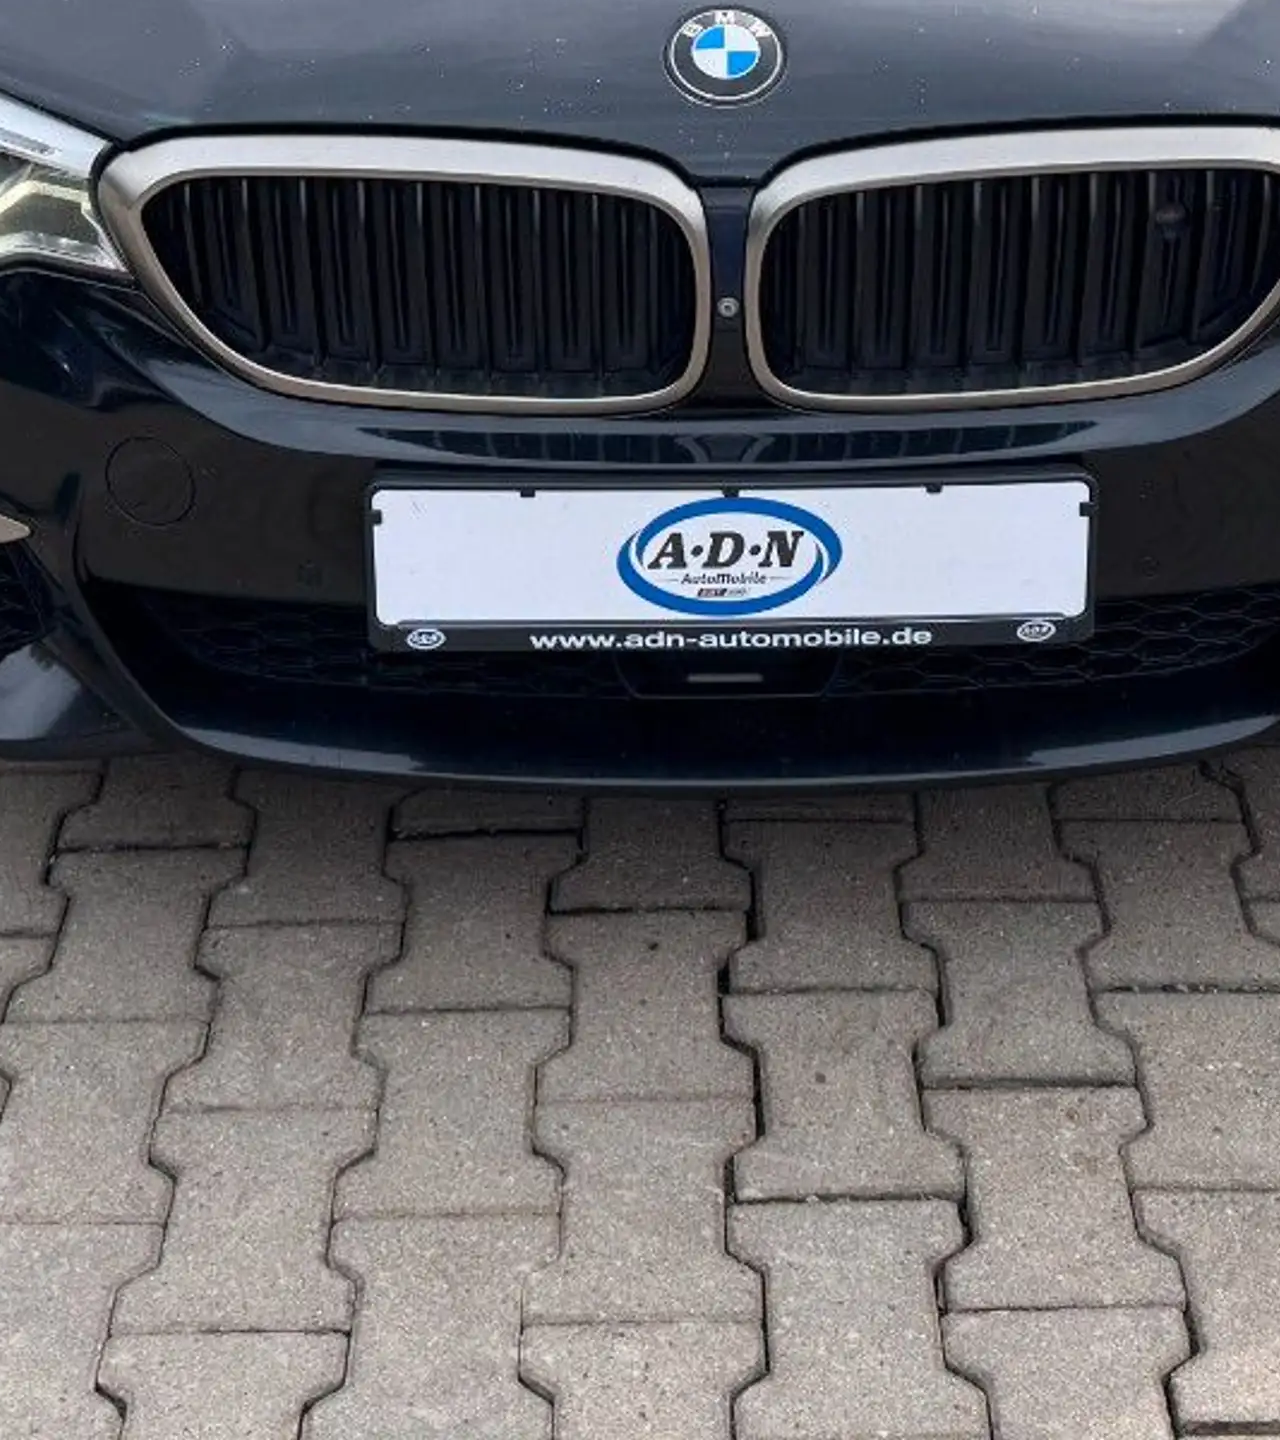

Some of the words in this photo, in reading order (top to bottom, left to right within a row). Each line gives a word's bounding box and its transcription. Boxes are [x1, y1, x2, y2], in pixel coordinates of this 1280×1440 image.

[680, 9, 772, 38] BMW
[647, 530, 805, 570] A·D·N
[681, 571, 767, 585] AutoMobile
[530, 627, 933, 649] www.adn-automobile.de
